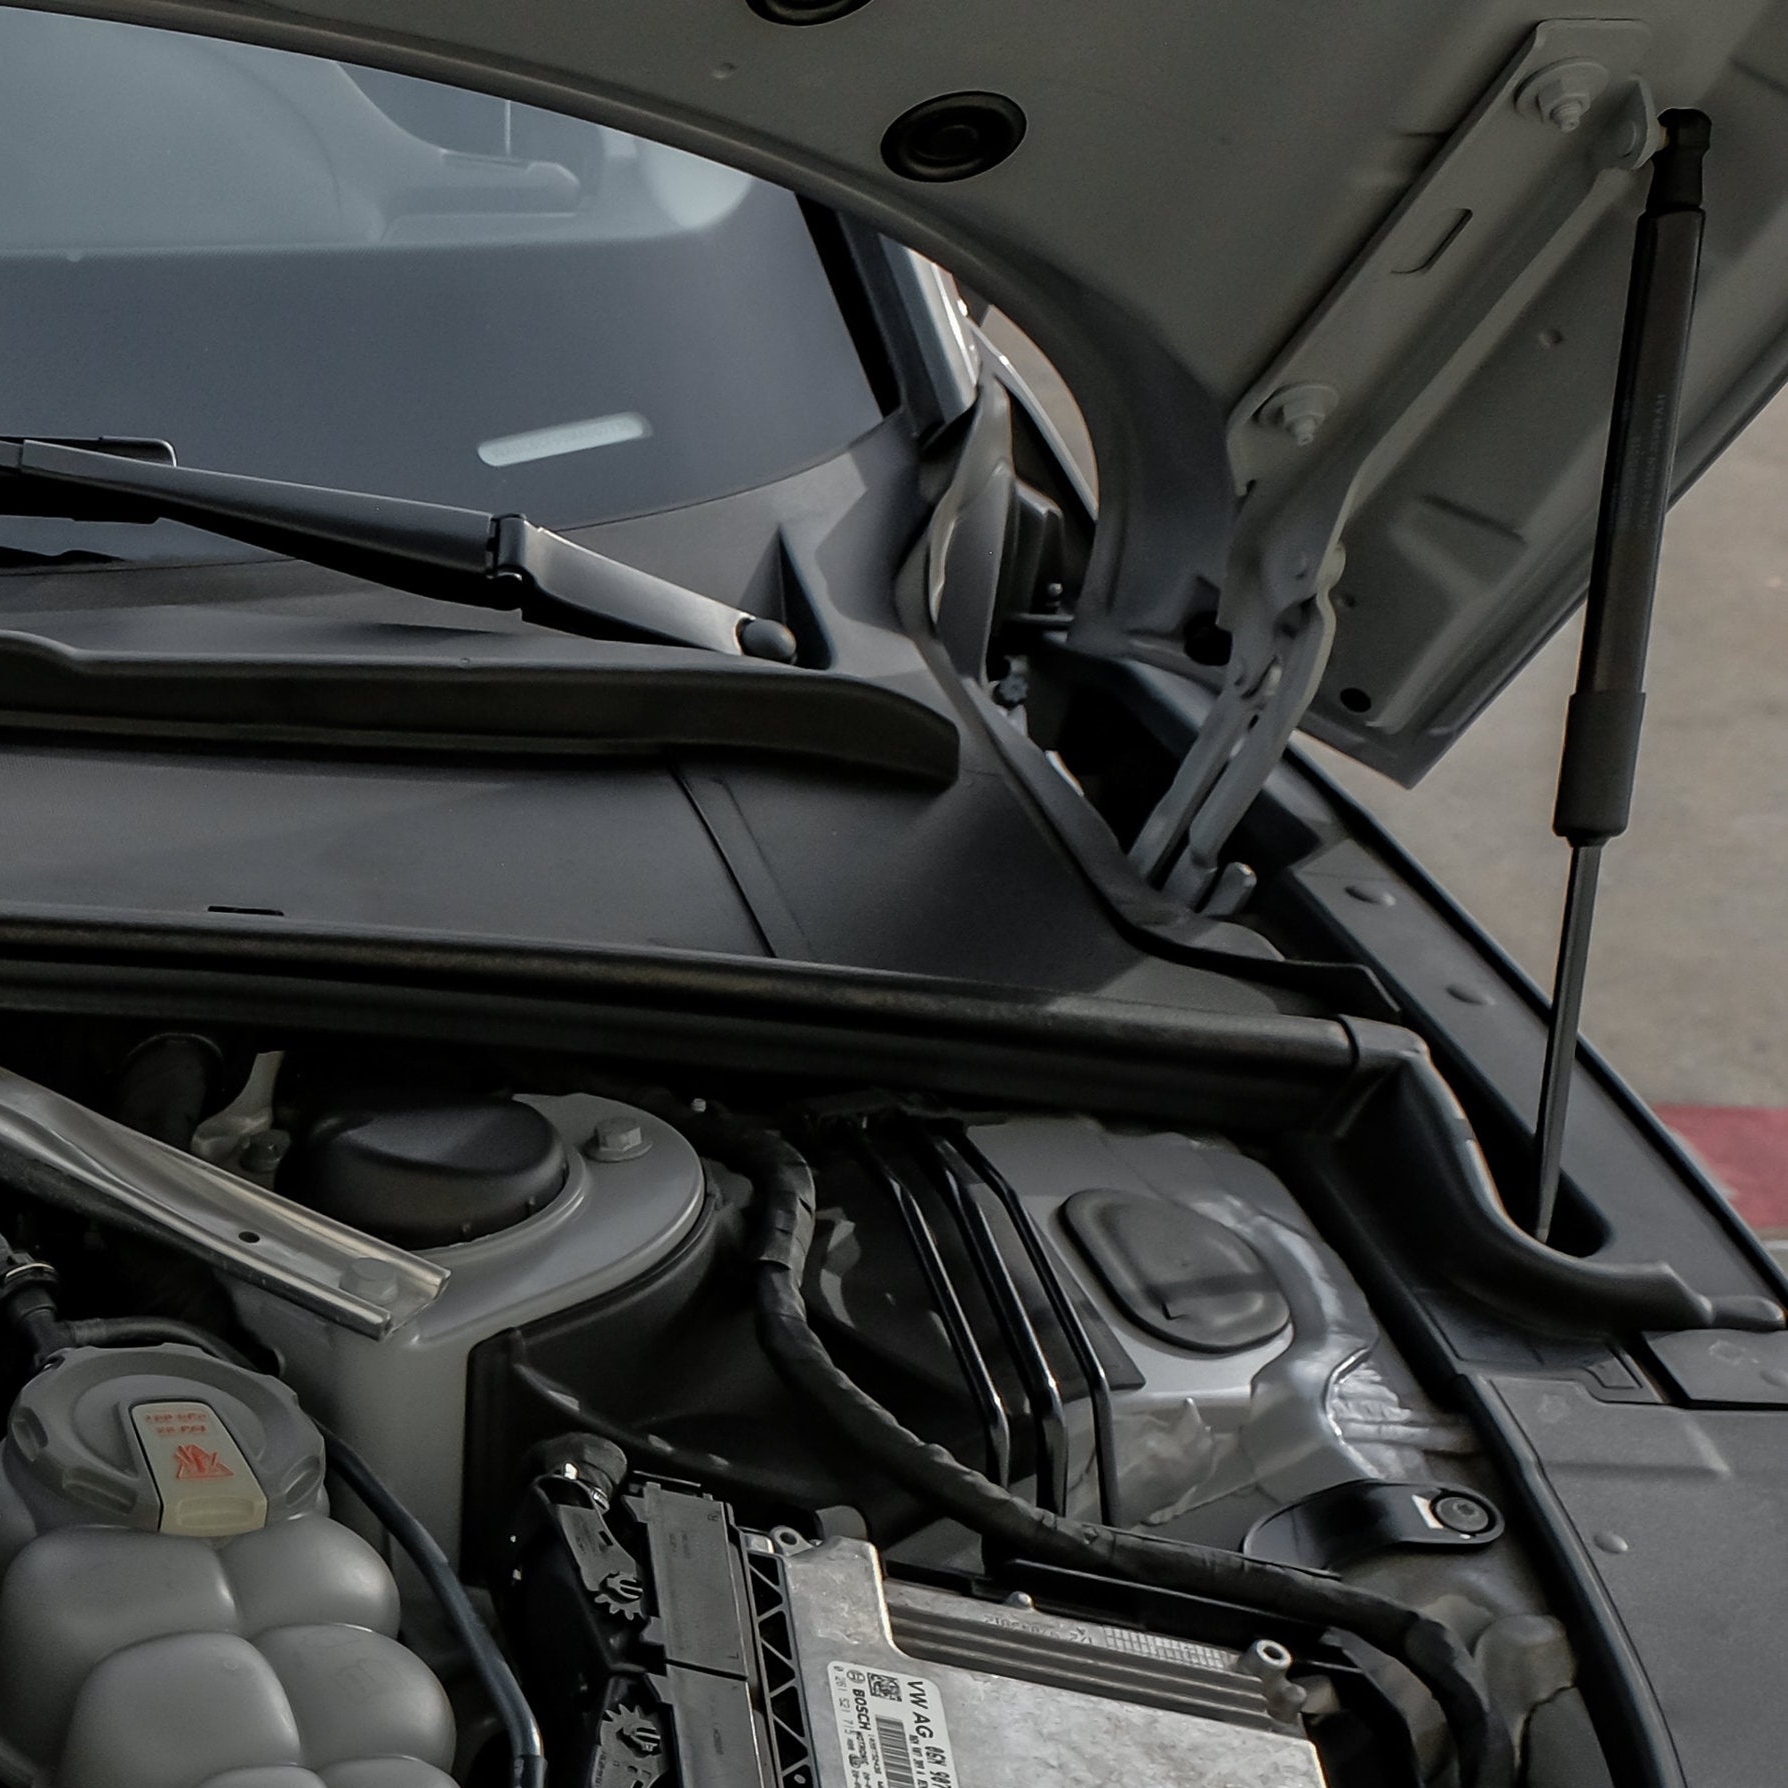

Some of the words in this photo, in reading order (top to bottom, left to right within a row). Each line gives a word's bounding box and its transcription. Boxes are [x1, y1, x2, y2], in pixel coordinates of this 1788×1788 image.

[852, 1688, 871, 1730] BOSCH
[907, 1681, 928, 1709] VW
[913, 1712, 934, 1738] AG
